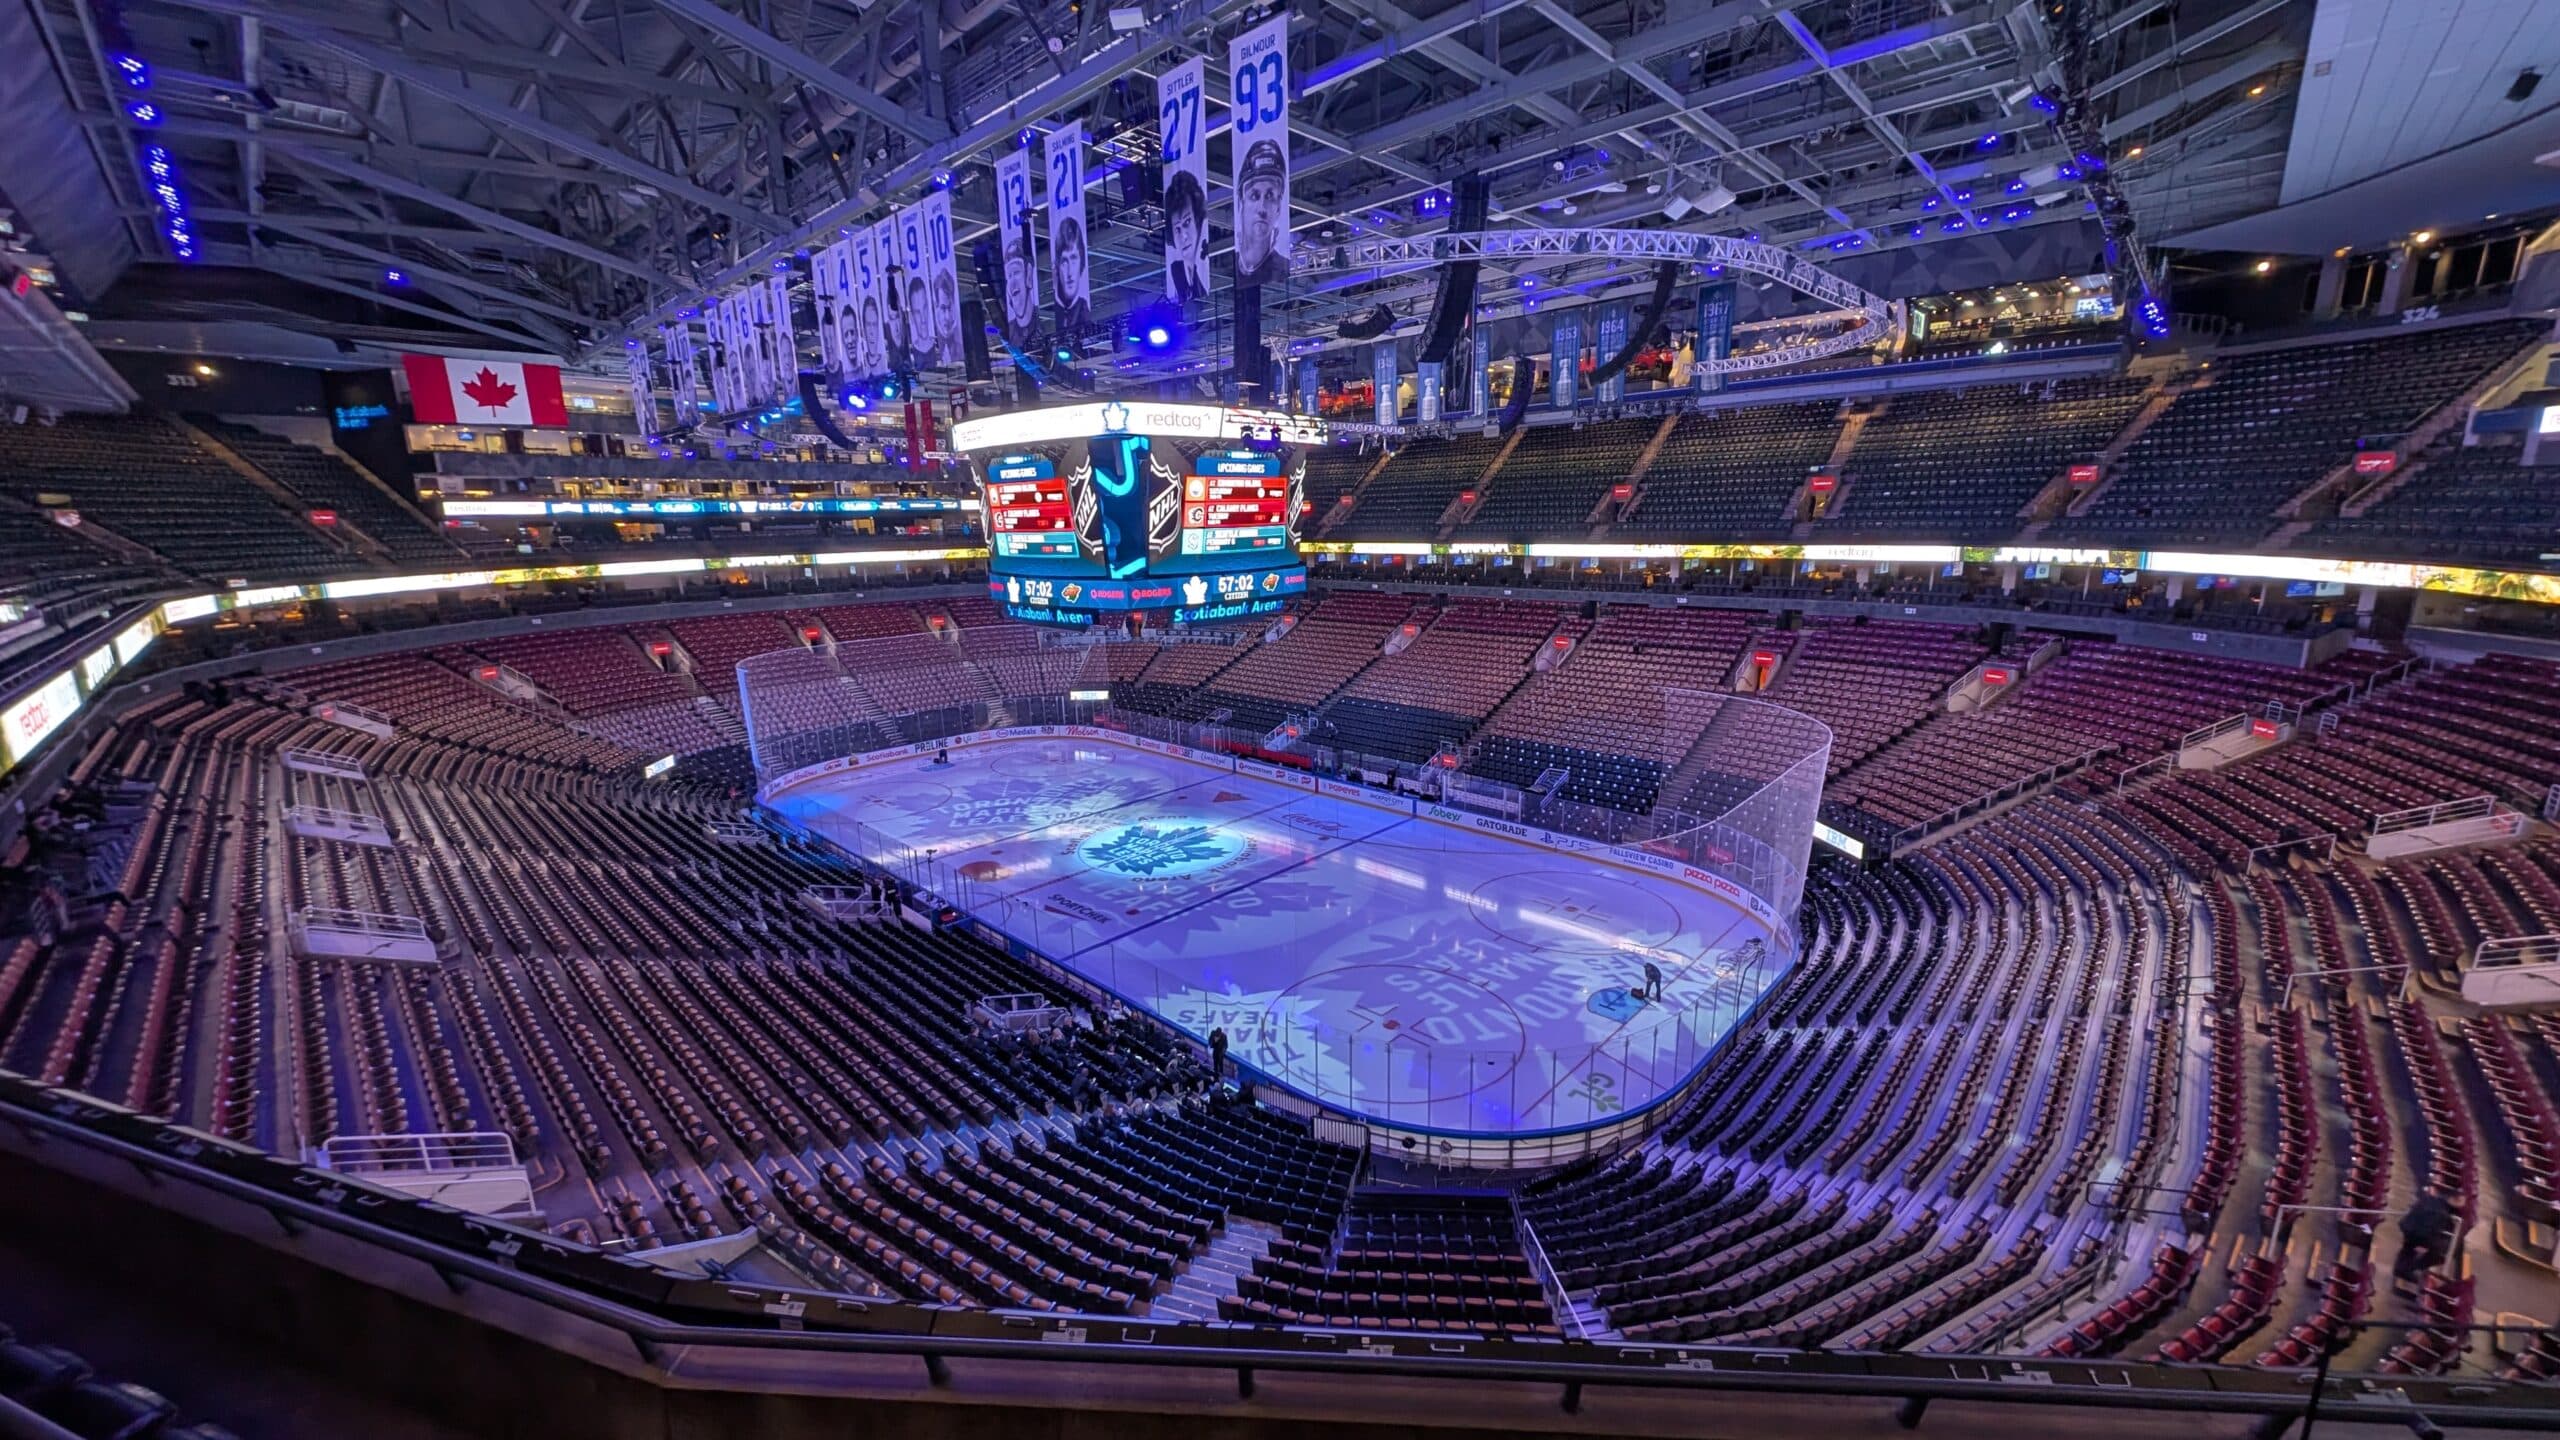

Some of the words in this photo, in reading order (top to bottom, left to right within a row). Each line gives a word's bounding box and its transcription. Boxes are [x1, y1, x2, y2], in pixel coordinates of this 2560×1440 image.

[1240, 33, 1276, 61] GILMOUR
[1166, 71, 1194, 93] SITTLER
[1235, 50, 1284, 135] 93
[1160, 86, 1200, 165] 27
[1052, 147, 1078, 210] 21
[1003, 174, 1025, 230] 13
[906, 226, 919, 270] 9
[929, 213, 949, 264] 10
[839, 258, 849, 297] 4
[858, 248, 871, 290] 5
[740, 306, 748, 338] 6
[1601, 318, 1624, 334] 1964
[1555, 326, 1577, 341] 1963
[1146, 413, 1201, 431] redtag
[1077, 484, 1096, 532] NHL
[1149, 487, 1179, 528] NHL
[1024, 580, 1053, 598] 57:02
[1141, 588, 1172, 599] ROGERS
[1218, 575, 1254, 593] 57:02
[1056, 610, 1093, 624] Arena
[1174, 602, 1249, 622] Scotiabank
[1251, 600, 1284, 613] Arena
[1009, 728, 1037, 737] Medals
[1065, 726, 1099, 736] Molson
[866, 748, 909, 762] Scotiabank
[914, 738, 949, 753] PROLINE
[1328, 783, 1361, 797] POPEYES
[1428, 805, 1462, 822] Sobeys
[1476, 817, 1528, 837] GATORADE
[1608, 847, 1647, 863] FALLSVIEW
[1647, 855, 1674, 870] CASINO
[1683, 867, 1713, 885] pizza
[1713, 878, 1740, 898] pizza
[1048, 893, 1112, 924] SPORTCHEK
[1178, 1009, 1280, 1026] LEAFS
